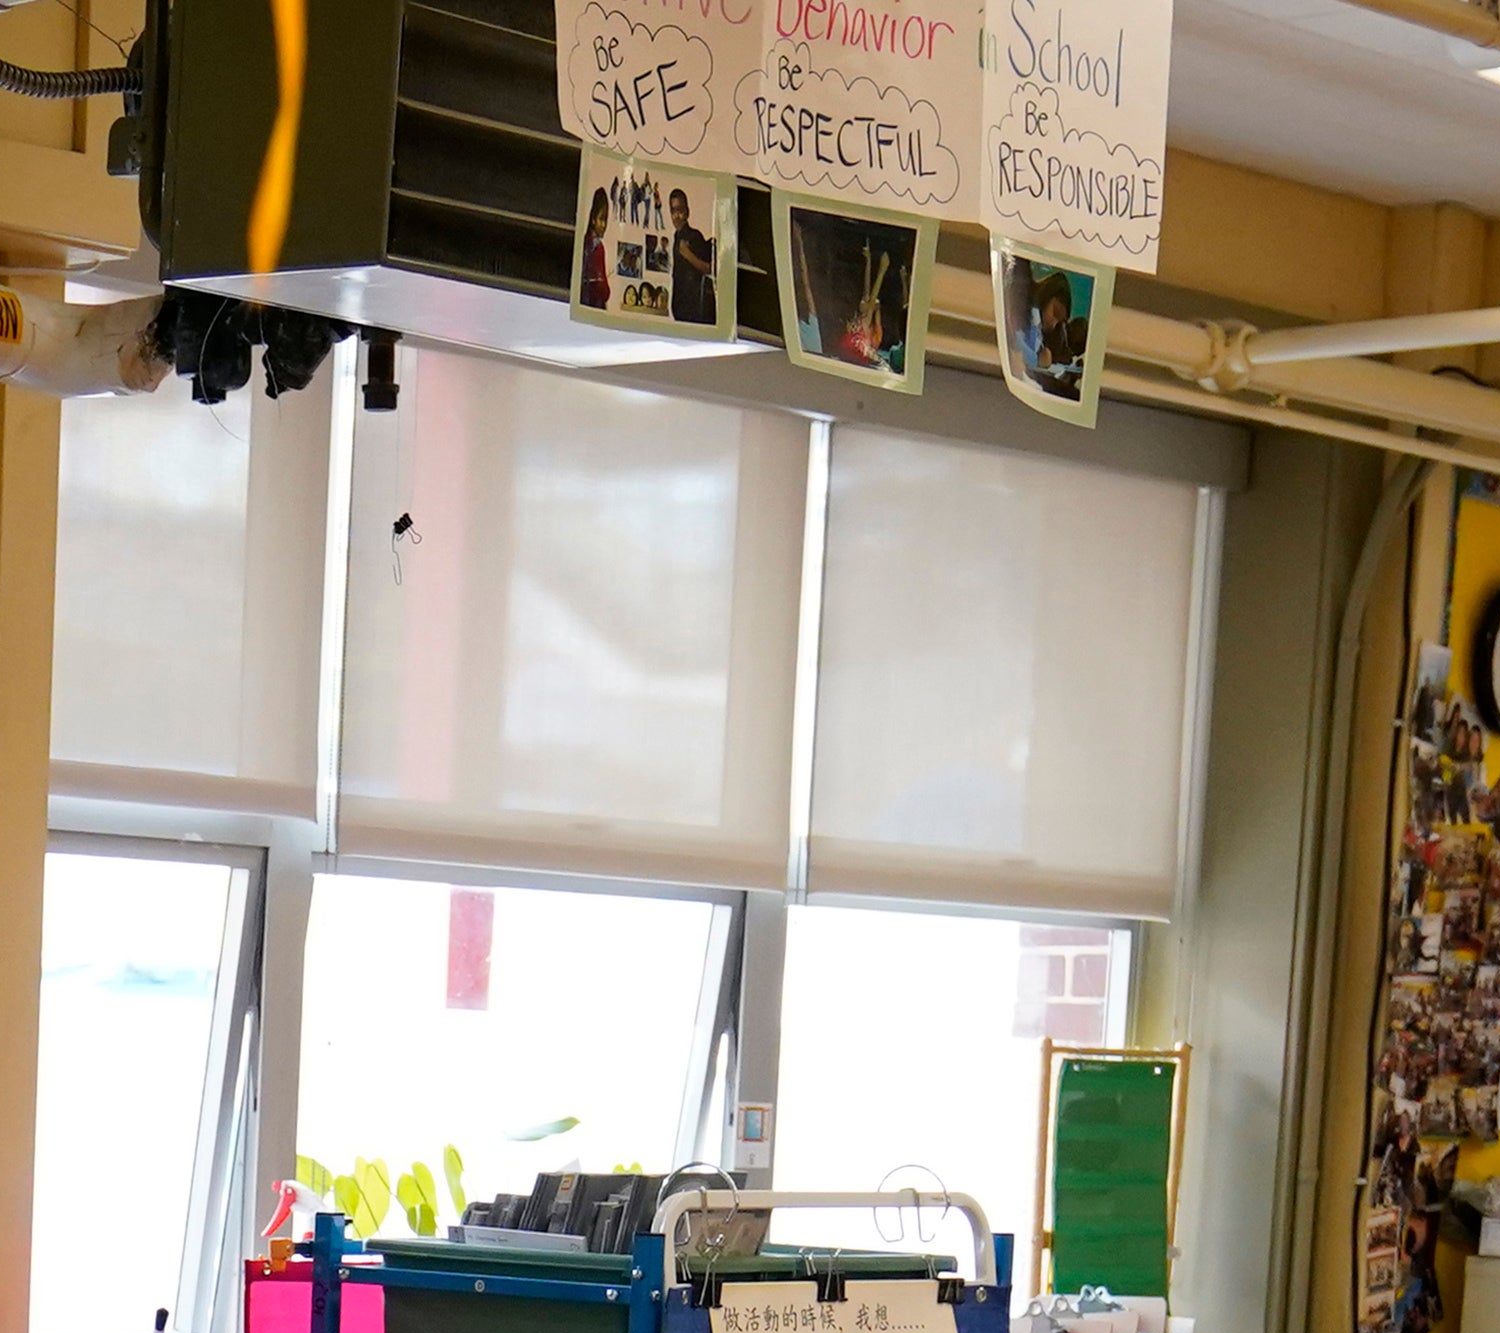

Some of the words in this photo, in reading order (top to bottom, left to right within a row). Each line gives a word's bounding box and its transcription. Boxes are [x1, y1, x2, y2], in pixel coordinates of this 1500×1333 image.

[593, 35, 624, 72] Be
[778, 55, 804, 91] Be
[1008, 0, 1123, 107] School
[589, 60, 696, 138] SAFE
[755, 97, 937, 177] RESPECTFUL
[1025, 101, 1049, 137] Be
[999, 142, 1159, 220] RESPONSIBLE
